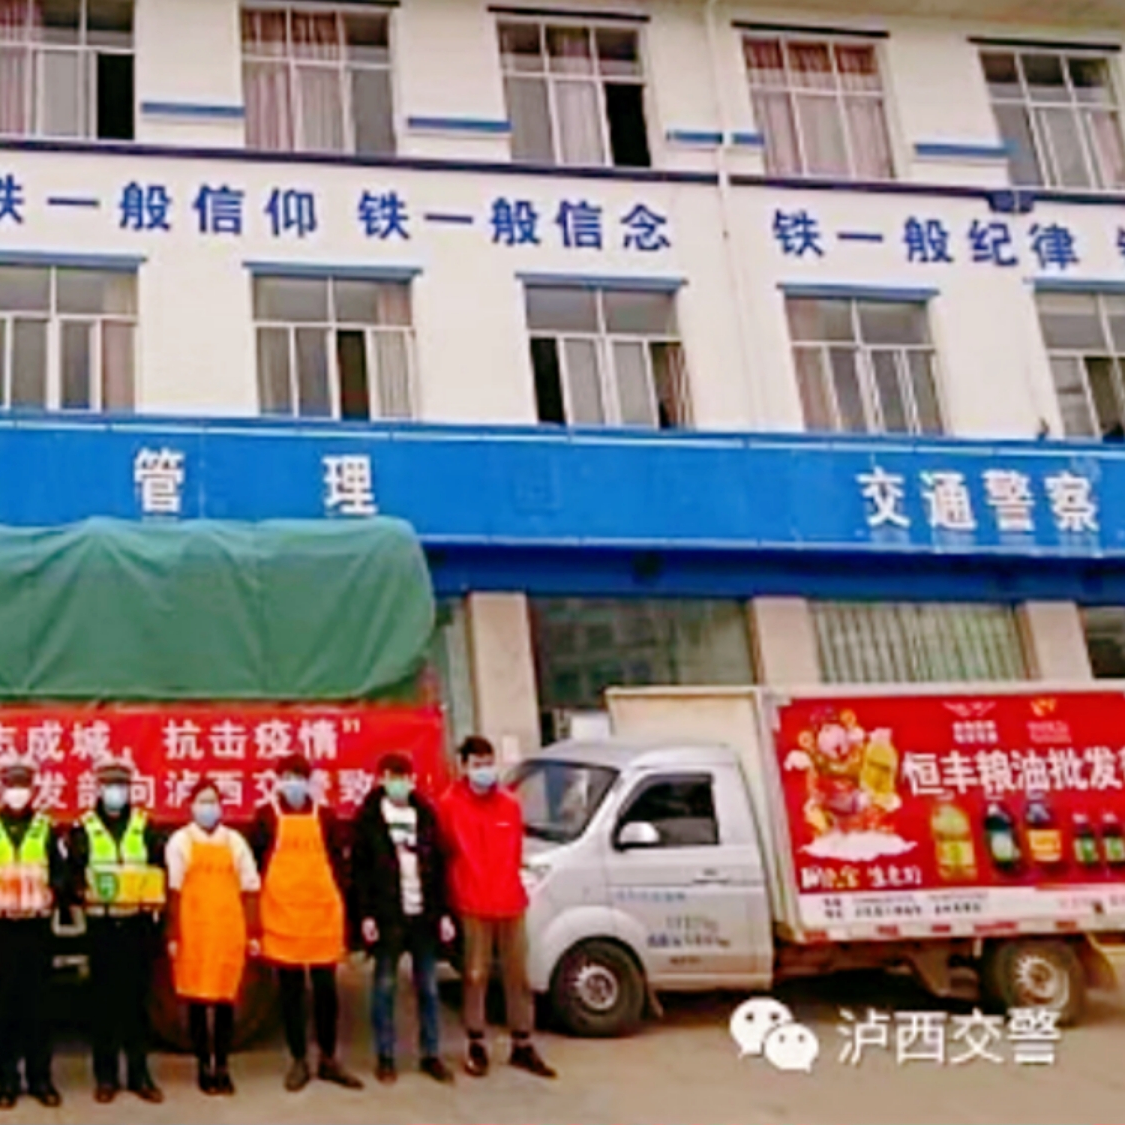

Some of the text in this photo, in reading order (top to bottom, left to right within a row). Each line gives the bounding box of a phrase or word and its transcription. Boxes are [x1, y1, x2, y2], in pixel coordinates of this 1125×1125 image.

[358, 193, 672, 252] 铁一般信念
[773, 208, 1081, 271] 铁一般纪律
[859, 468, 1101, 532] 交通警察
[902, 745, 1125, 797] 恒丰粮油批发
